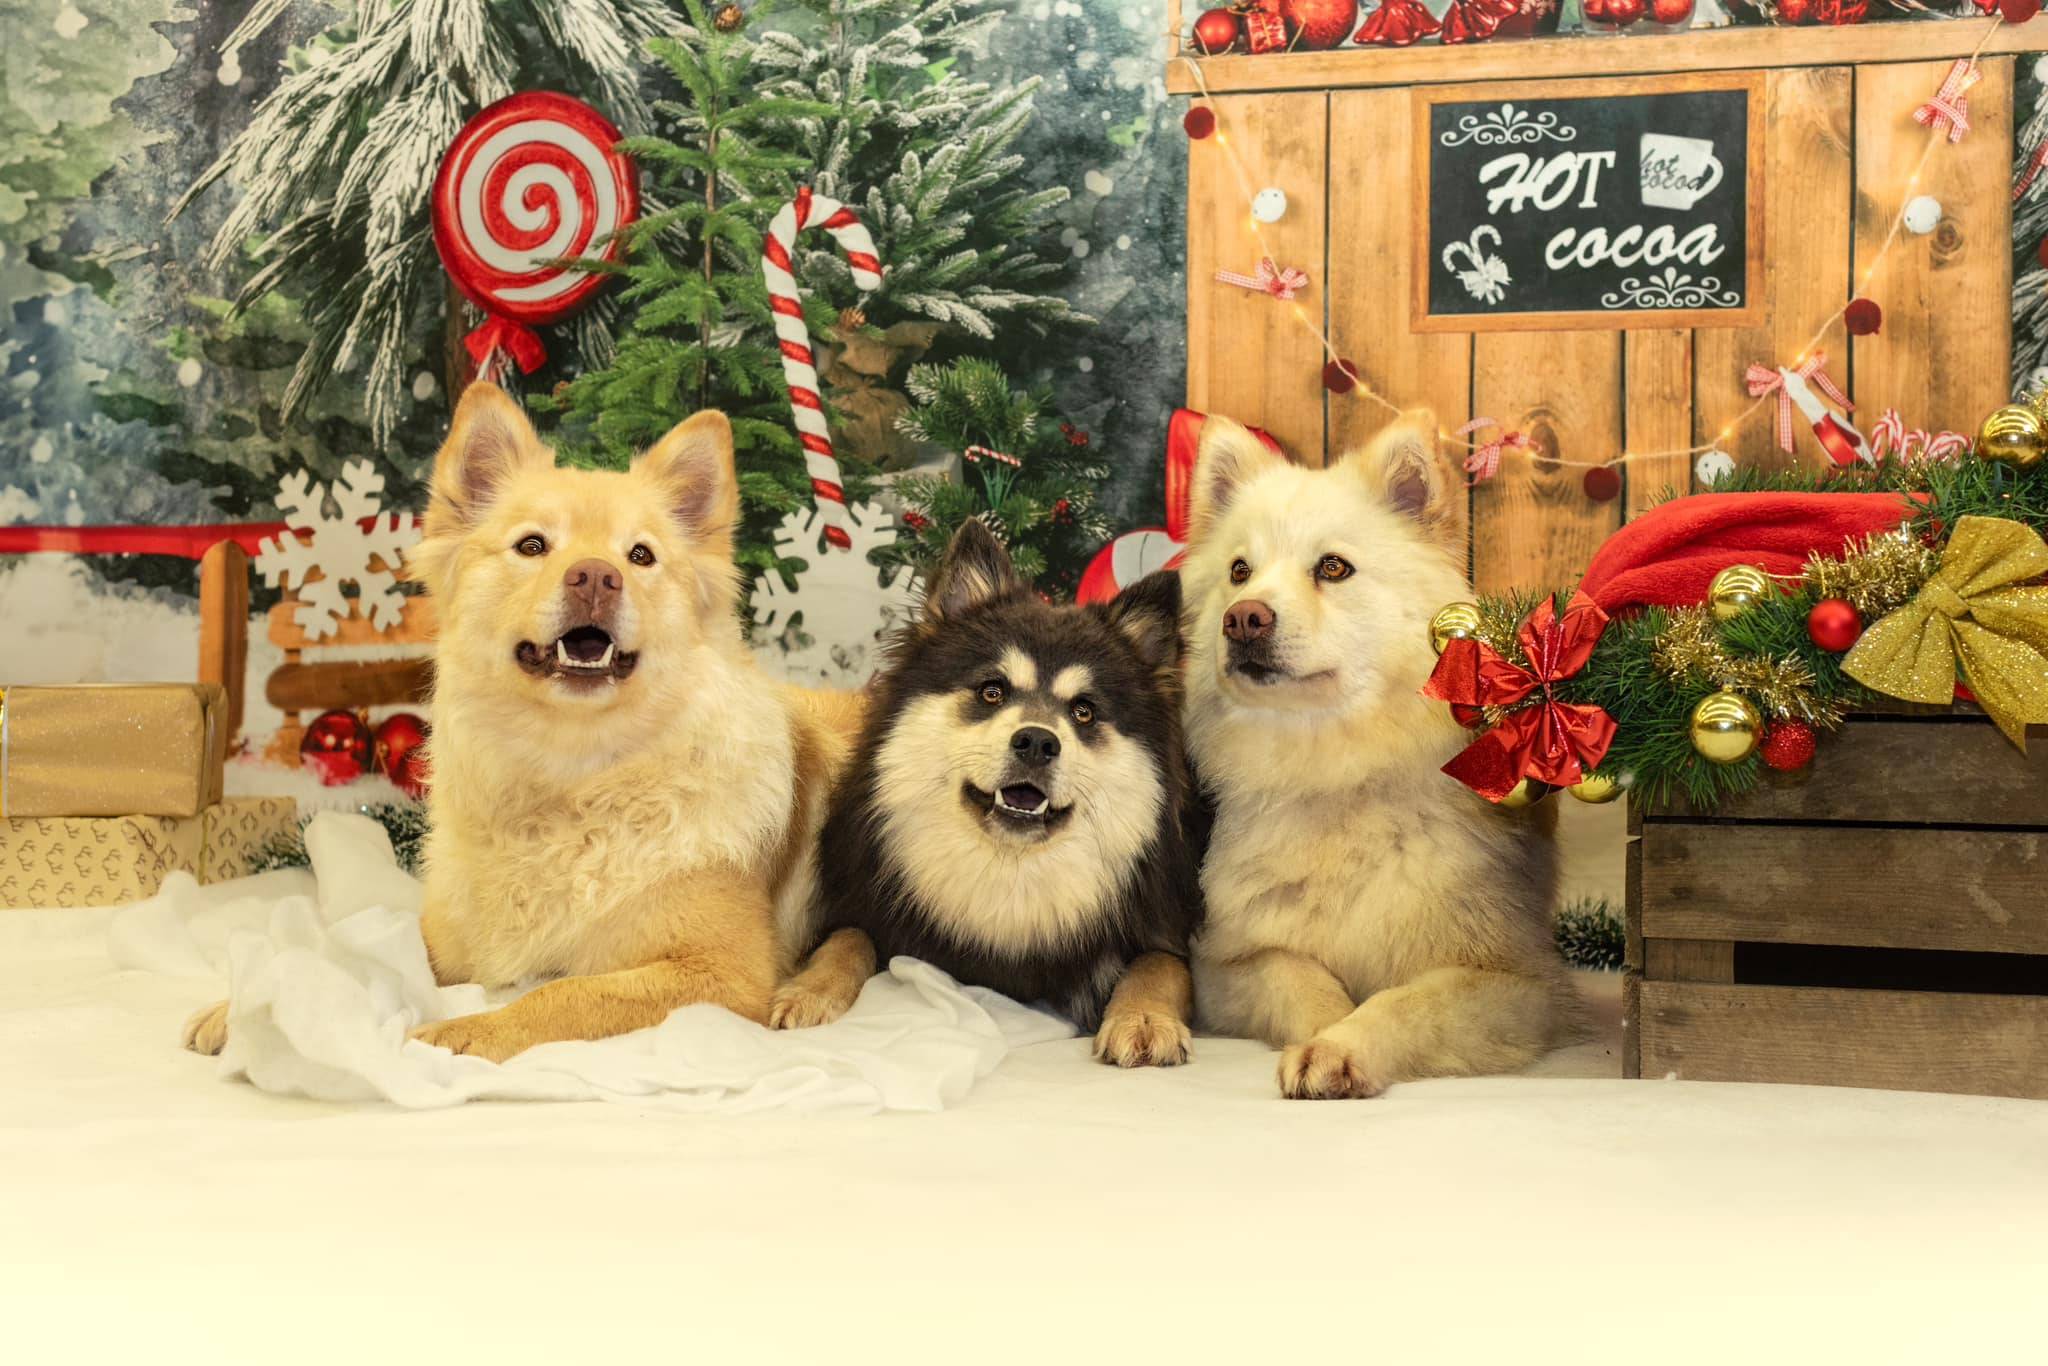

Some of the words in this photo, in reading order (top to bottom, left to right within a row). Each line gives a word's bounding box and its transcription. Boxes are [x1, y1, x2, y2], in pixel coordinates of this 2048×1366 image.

[1640, 148, 1680, 174] hot
[1479, 150, 1616, 215] HOT
[1640, 173, 1704, 191] cocoa
[1545, 223, 1726, 270] cocoa
